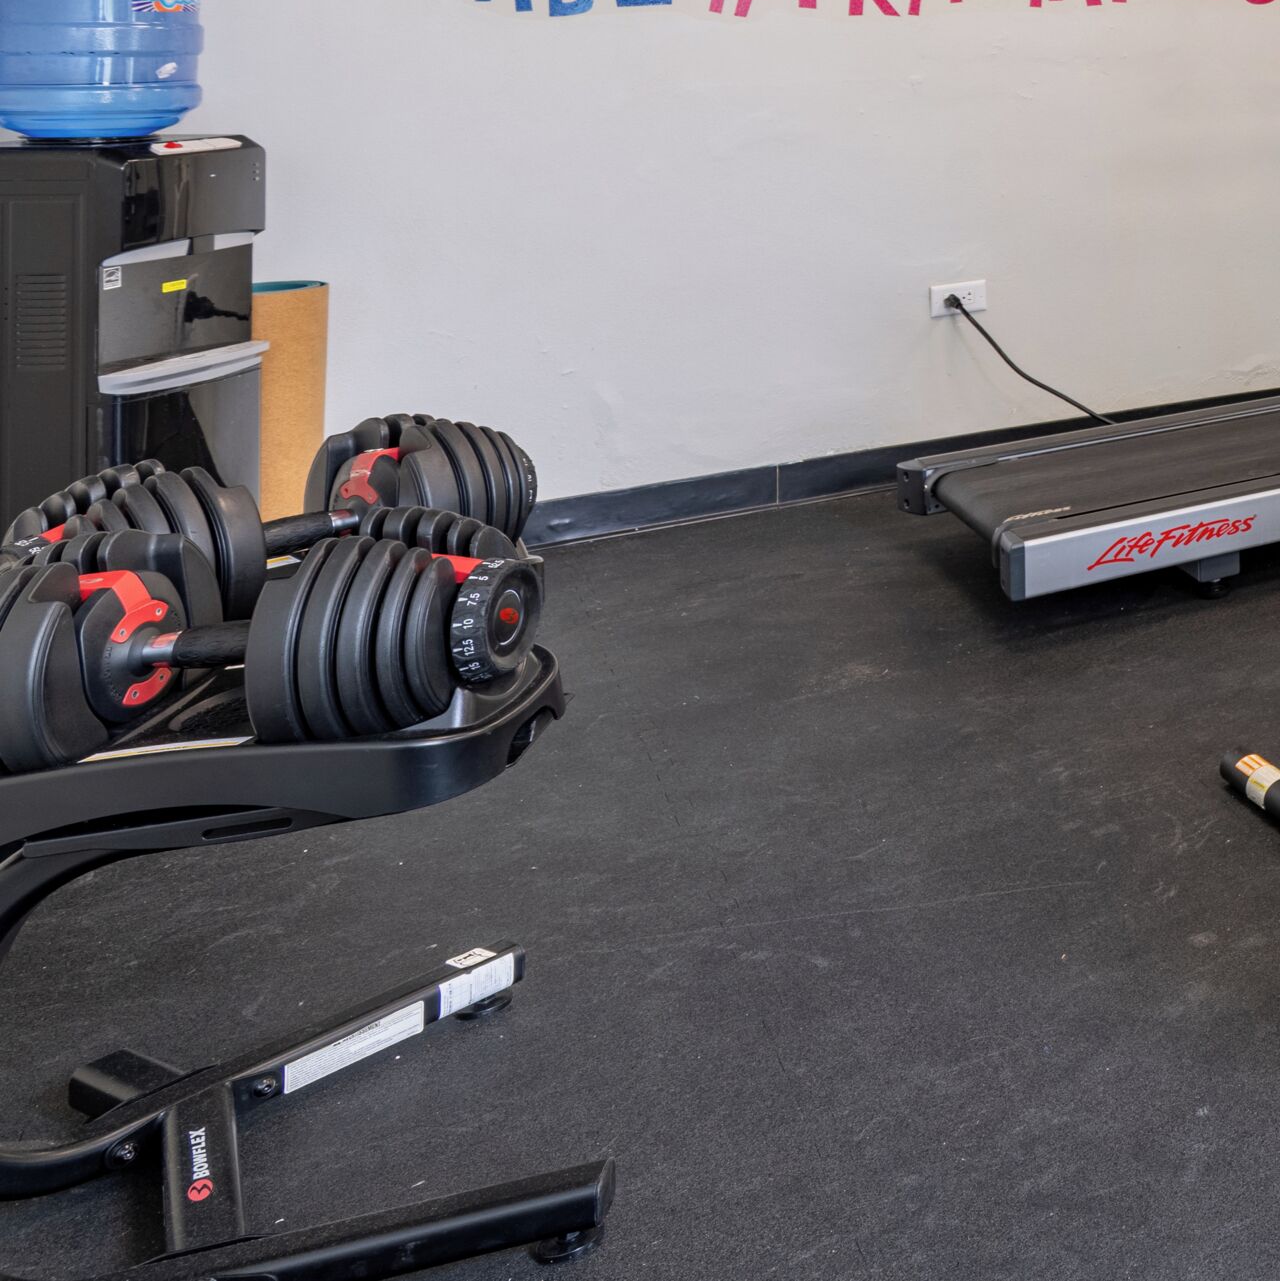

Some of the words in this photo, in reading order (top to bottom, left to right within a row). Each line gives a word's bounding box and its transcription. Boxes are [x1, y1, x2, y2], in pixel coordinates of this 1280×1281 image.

[467, 592, 480, 606] 7.5
[463, 618, 474, 629] 10
[462, 639, 475, 656] 12.5
[468, 661, 480, 671] 15
[188, 1126, 210, 1181] BOWFLEX
